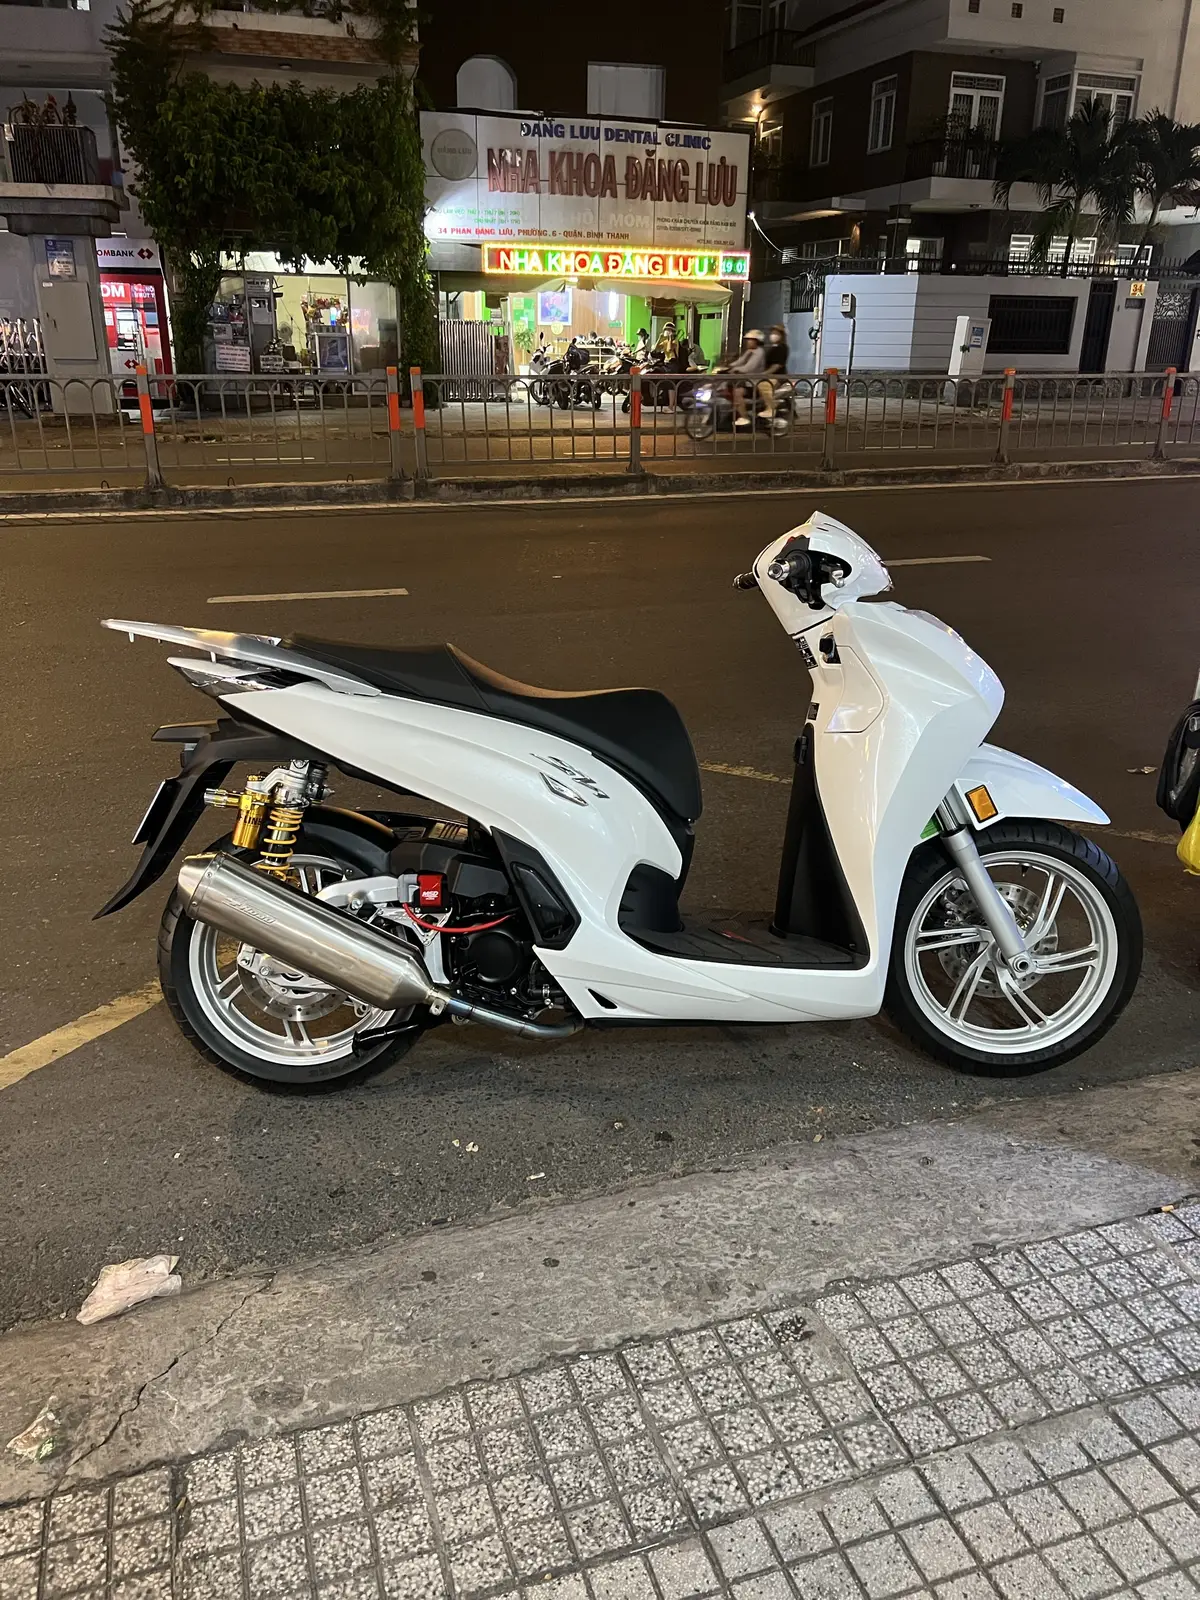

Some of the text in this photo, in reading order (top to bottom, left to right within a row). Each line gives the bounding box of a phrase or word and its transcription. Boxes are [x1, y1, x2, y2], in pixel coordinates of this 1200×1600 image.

[604, 127, 661, 146] DENTAL
[665, 133, 711, 150] CLINIC
[487, 148, 738, 207] NHA KHOA ĐĂNG LƯU
[500, 251, 543, 271] NHA
[547, 252, 603, 273] KHOA
[608, 252, 664, 276] ĐĂNG
[1132, 284, 1143, 292] 34
